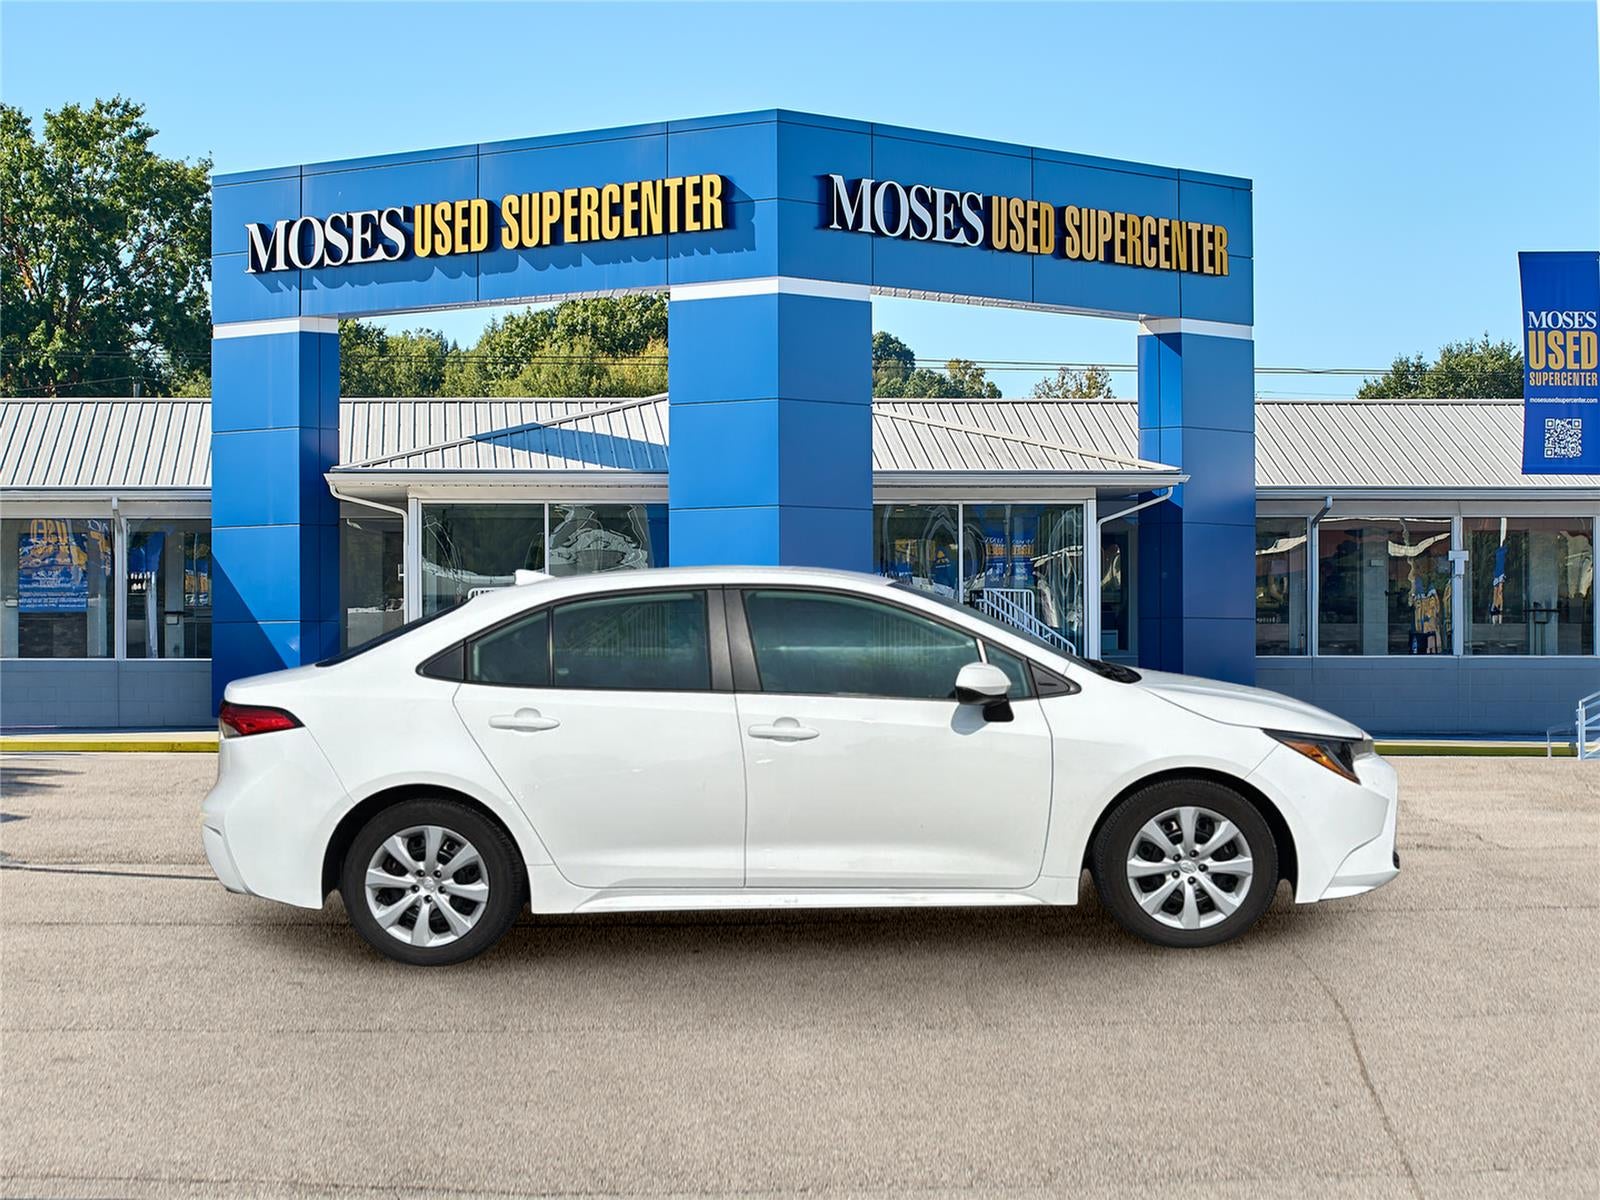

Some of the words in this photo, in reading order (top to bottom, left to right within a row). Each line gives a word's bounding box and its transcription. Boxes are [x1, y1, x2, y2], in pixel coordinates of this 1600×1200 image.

[245, 206, 408, 274] MOSES
[413, 198, 489, 258] USED
[500, 173, 724, 251] SUPERCENTER
[829, 173, 984, 247] MOSES
[991, 195, 1055, 254] USED
[1064, 205, 1229, 276] SUPERCENTER
[1527, 311, 1597, 329] MOSES
[1528, 330, 1598, 370] USED
[1529, 372, 1598, 387] SUPERCENTER
